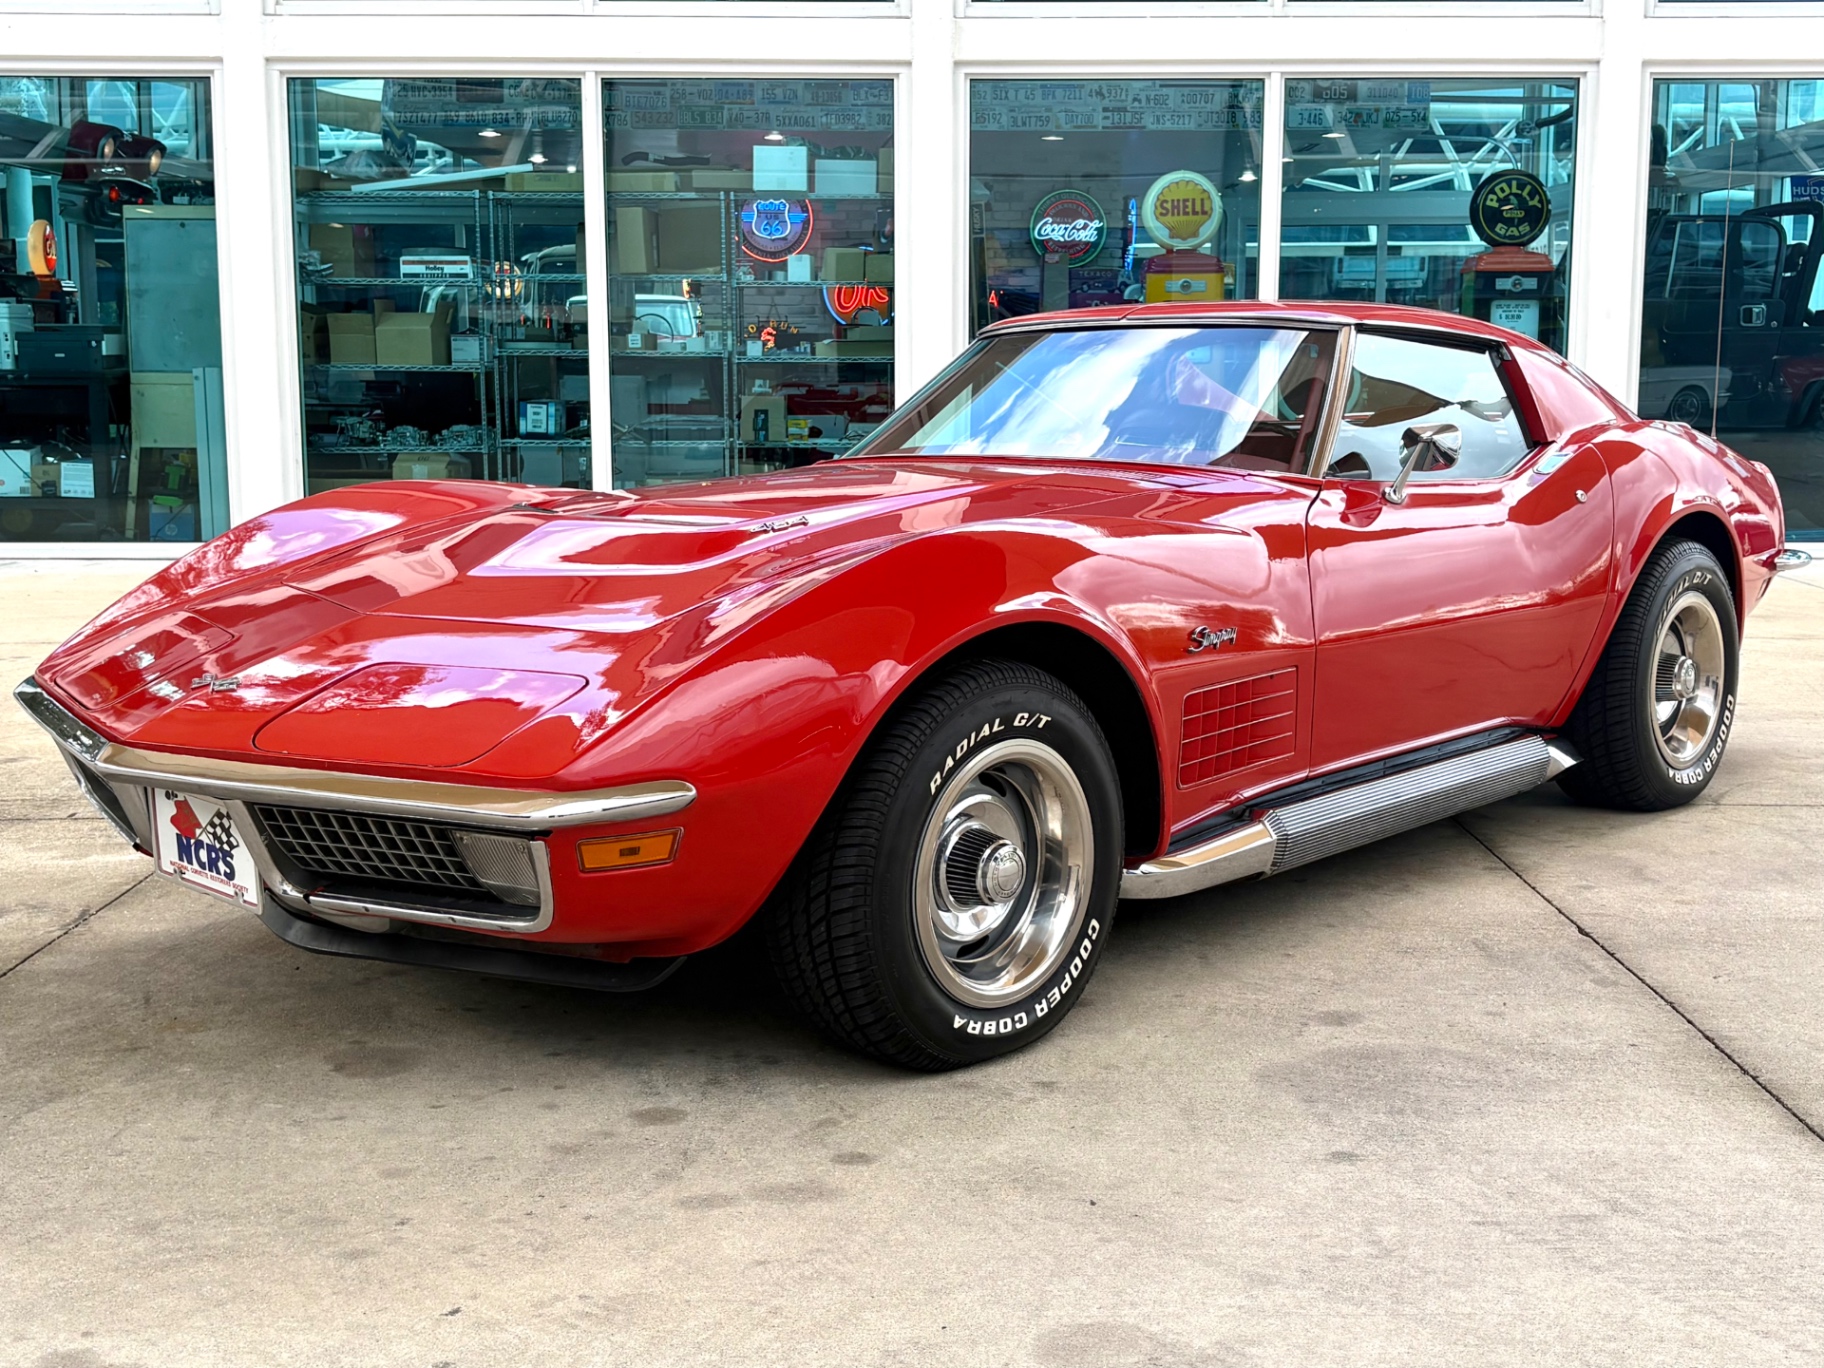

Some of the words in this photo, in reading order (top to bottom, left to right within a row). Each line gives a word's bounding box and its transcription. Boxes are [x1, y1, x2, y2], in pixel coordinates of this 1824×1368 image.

[634, 112, 654, 125] 543
[1485, 180, 1542, 208] POLLY
[1159, 198, 1208, 216] SHELL
[760, 221, 783, 235] 66
[1494, 223, 1531, 237] GAS
[1692, 571, 1712, 585] G/T
[1703, 694, 1735, 773] COOPER
[929, 718, 1005, 796] RADIAL
[1013, 712, 1052, 729] G/T
[1667, 766, 1704, 785] COBRA
[175, 832, 235, 882] NCRS
[1033, 917, 1101, 1018] COOPER
[952, 1011, 1029, 1036] COBRA
